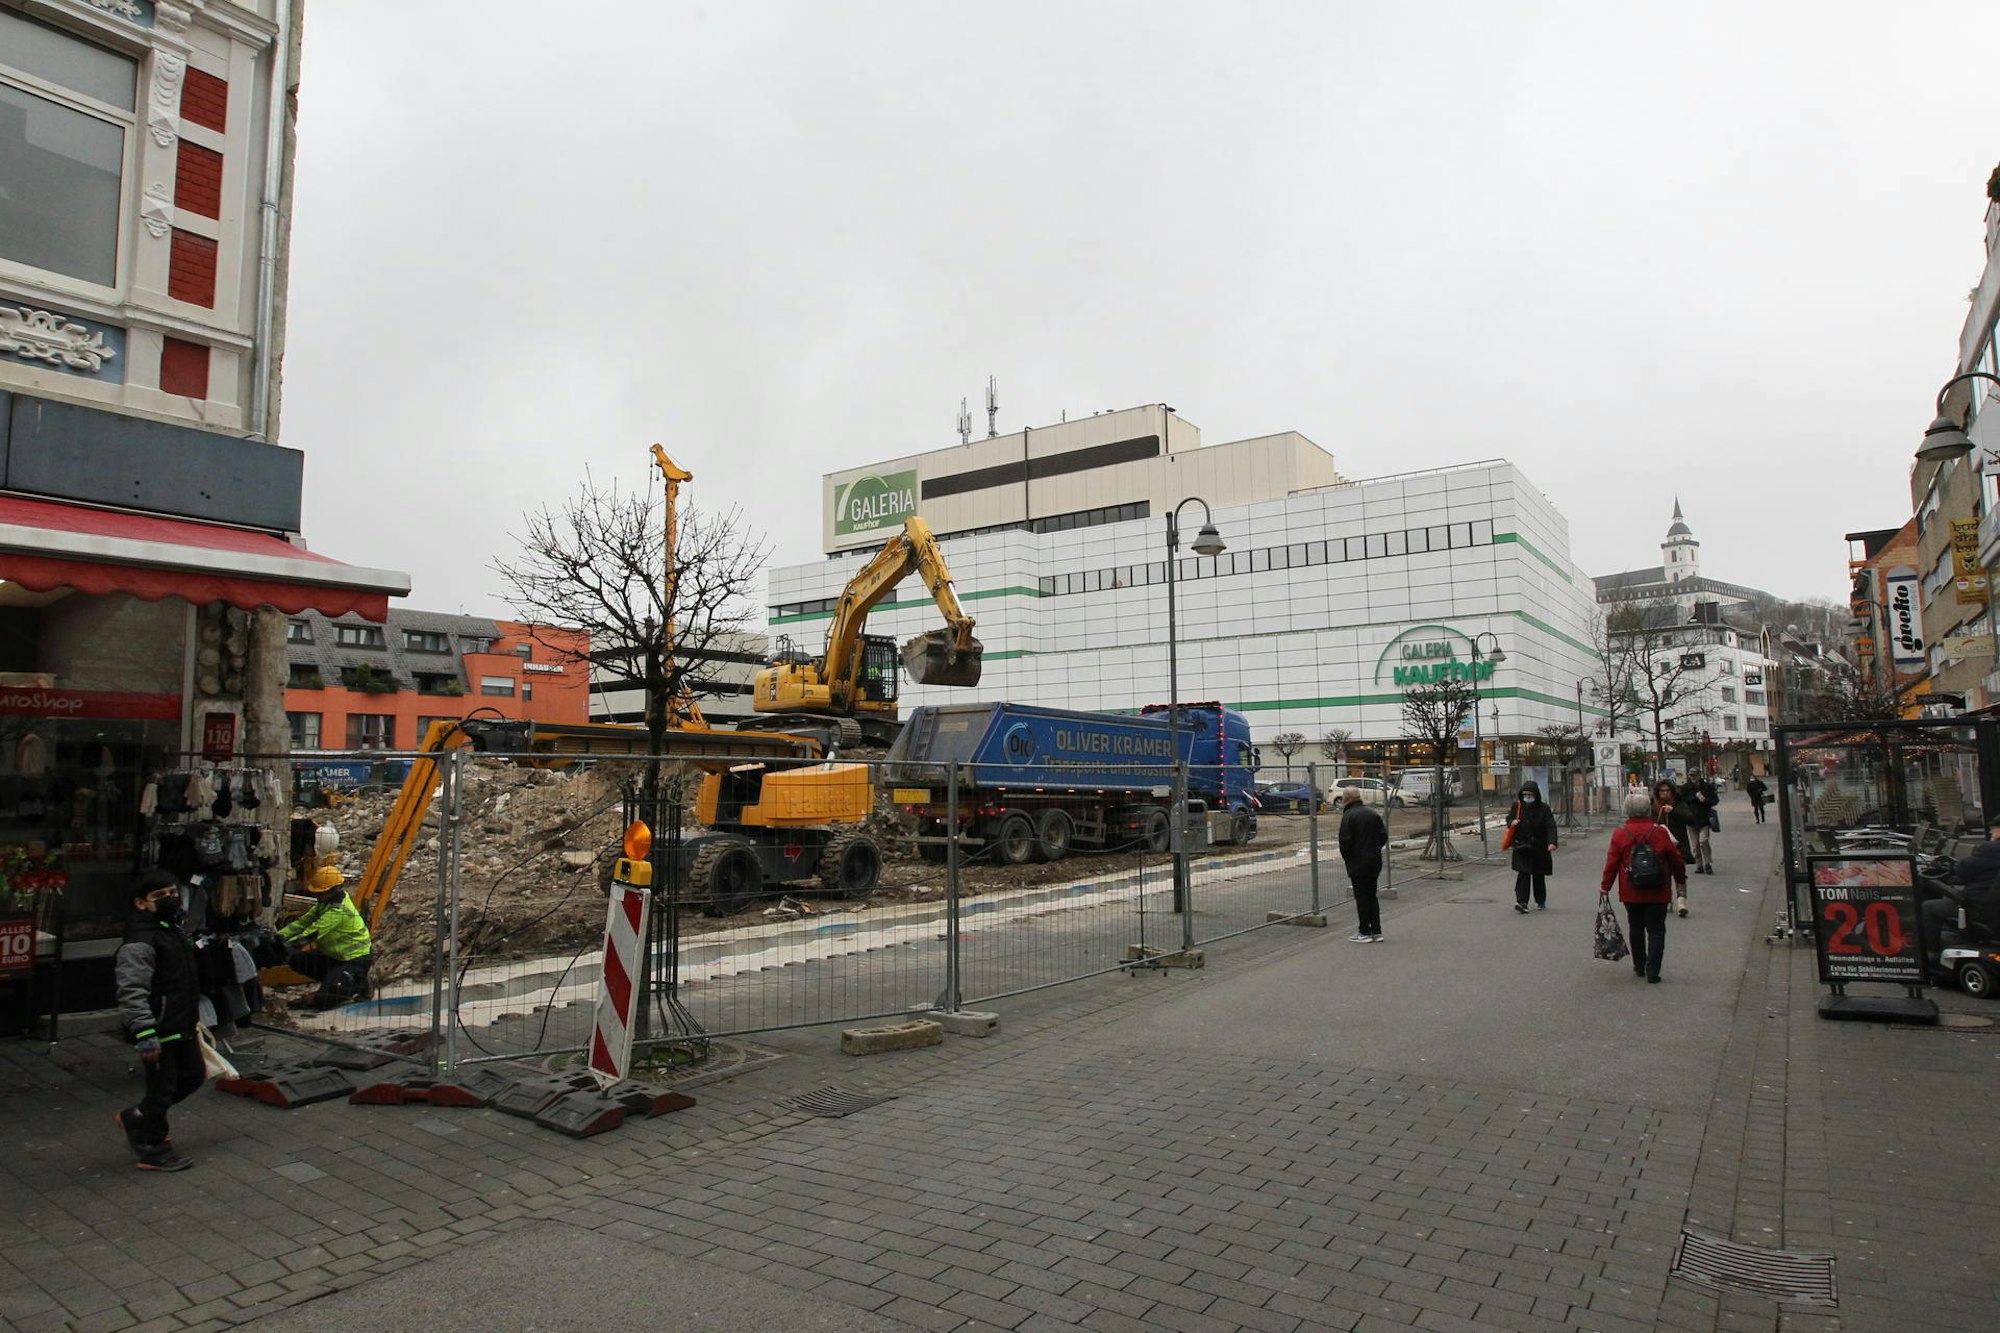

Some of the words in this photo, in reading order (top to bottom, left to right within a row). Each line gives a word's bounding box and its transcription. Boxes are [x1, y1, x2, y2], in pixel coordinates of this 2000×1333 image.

[851, 488, 915, 521] GALERIA
[1402, 641, 1454, 661] GALERIA
[1056, 730, 1110, 754] OLIVER
[1114, 733, 1173, 758] KRÄMER
[1110, 758, 1131, 776] und
[1818, 888, 1849, 900] TOM
[1851, 889, 1880, 900] Nails
[0, 925, 31, 934] ALLES
[1823, 902, 1904, 955] 20
[1847, 965, 1857, 973] für
